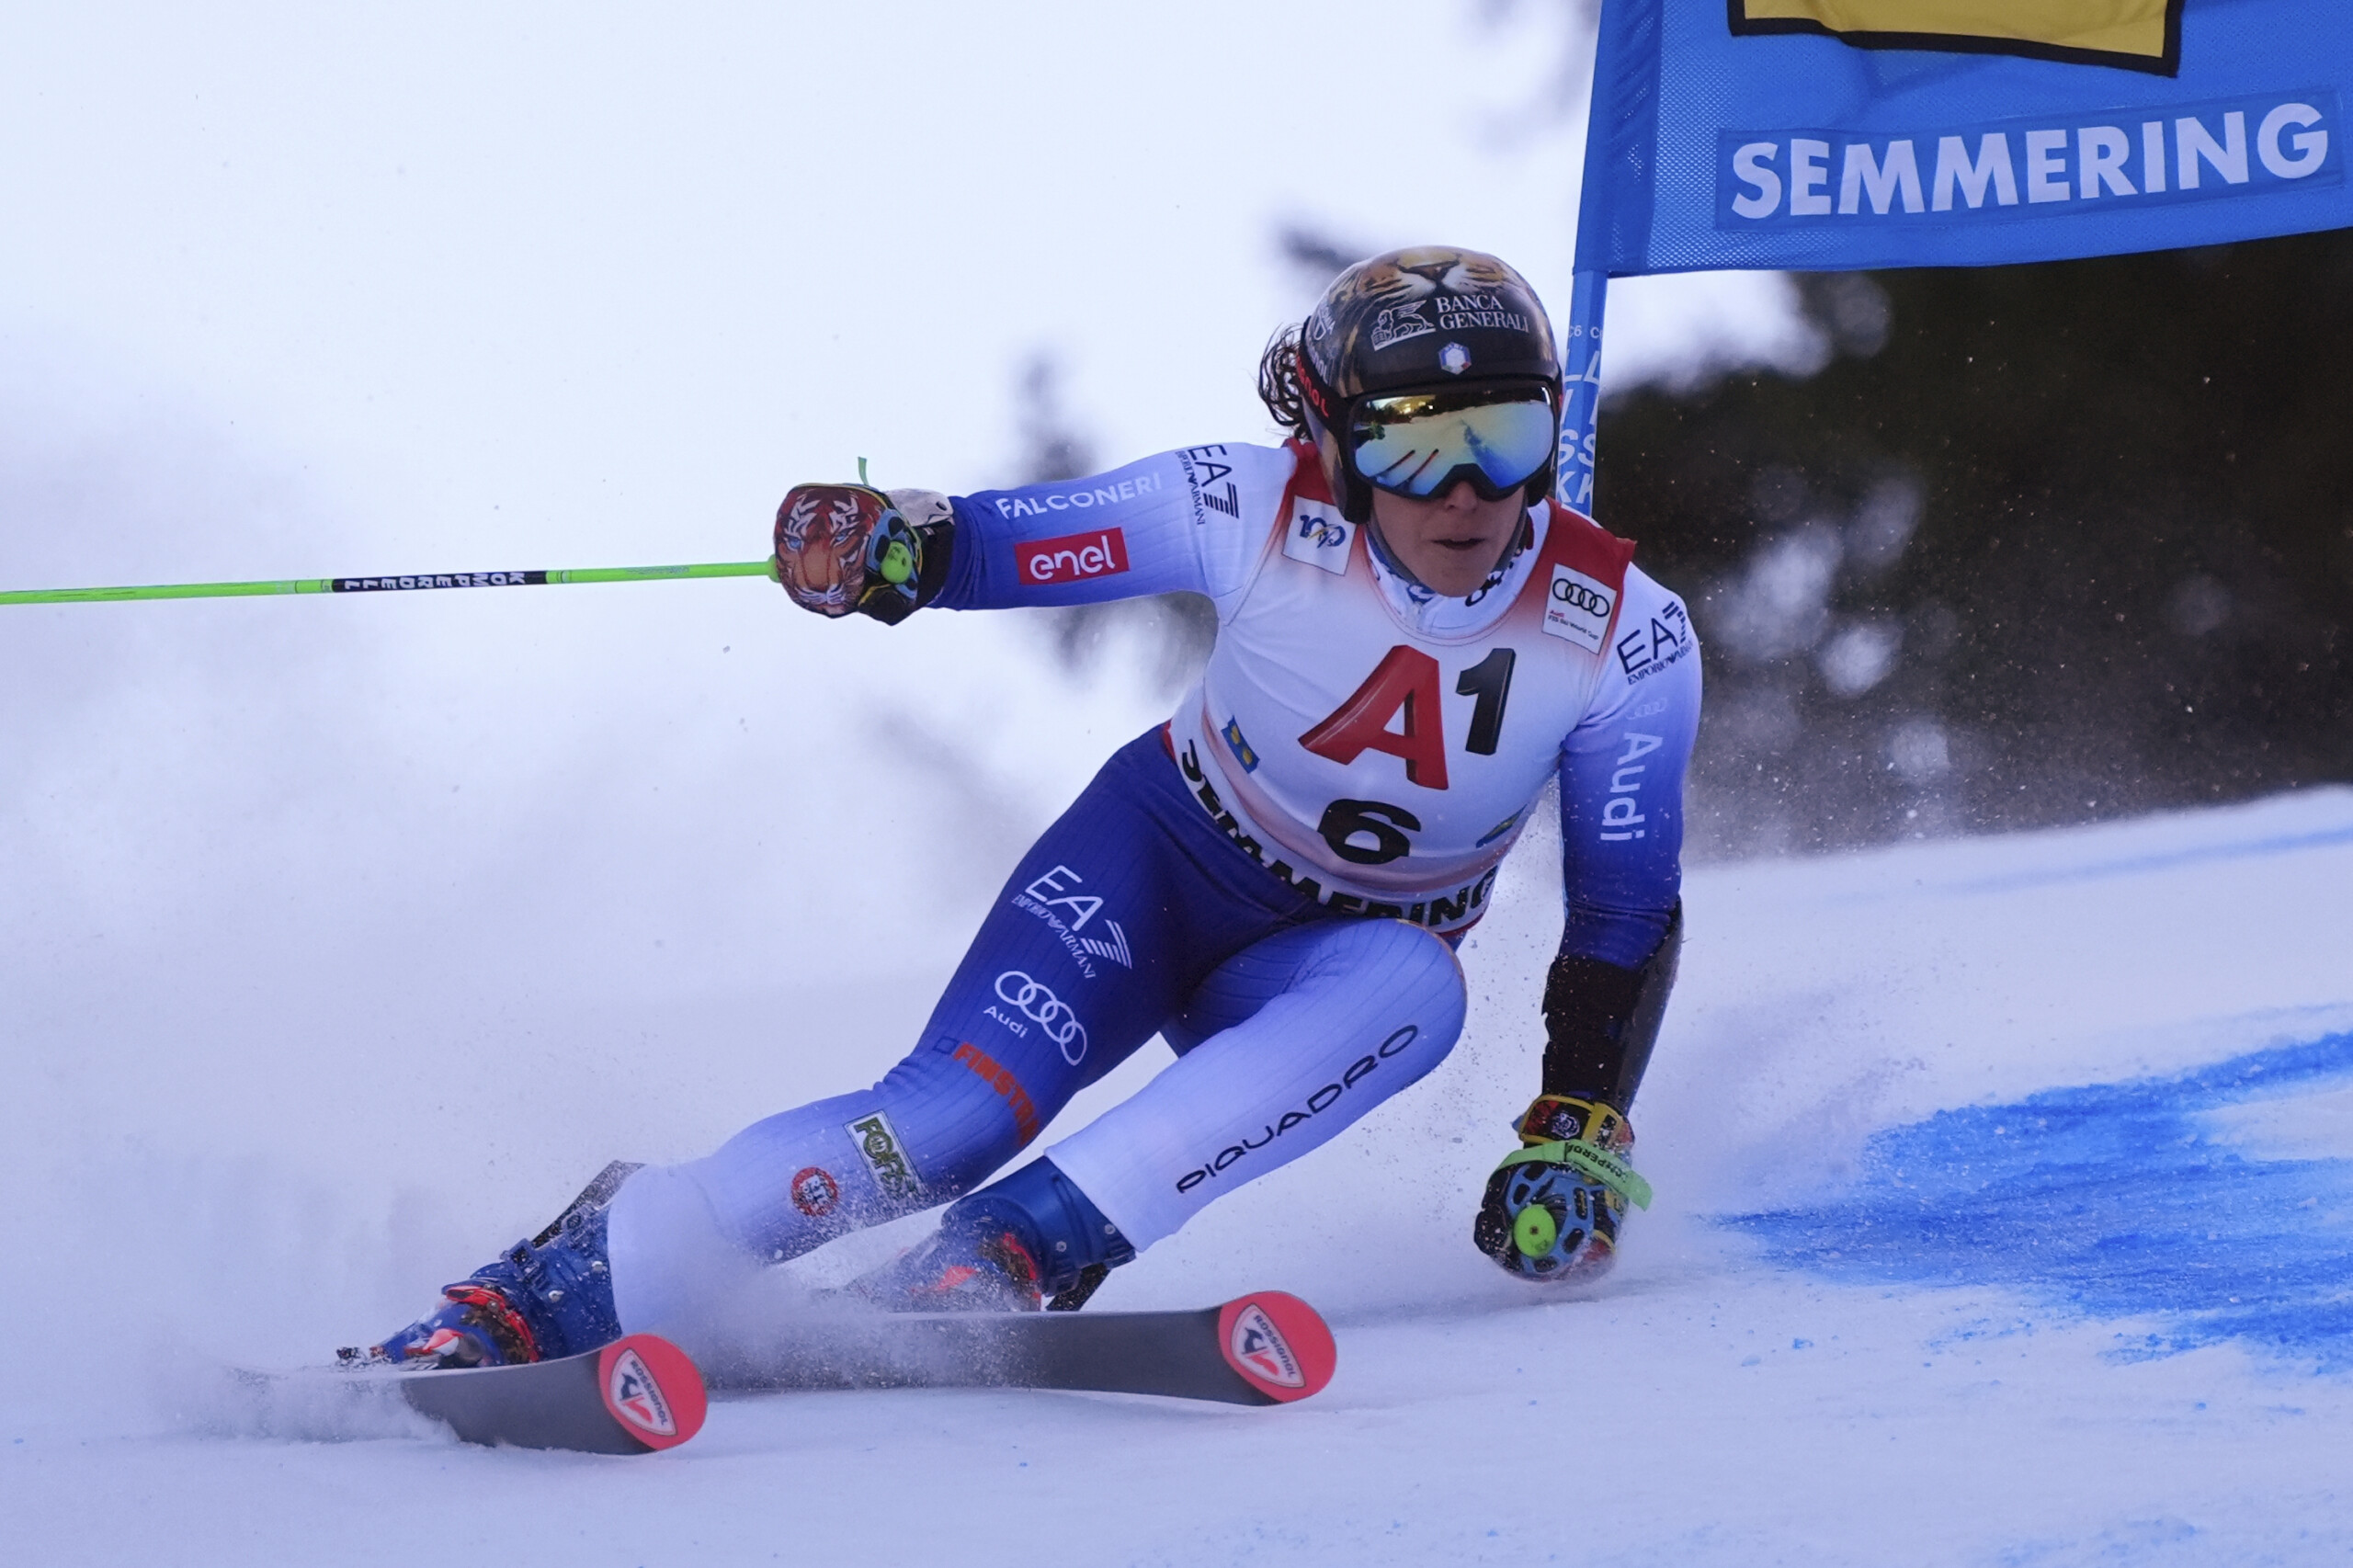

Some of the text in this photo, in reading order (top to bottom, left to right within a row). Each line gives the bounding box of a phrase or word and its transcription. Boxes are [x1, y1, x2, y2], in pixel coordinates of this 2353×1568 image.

[1731, 102, 2329, 220] SEMMERING
[1437, 294, 1504, 313] BANCA
[1439, 310, 1529, 334] GENERALI
[995, 472, 1162, 520] FALCONERI
[1188, 444, 1239, 519] EA7
[345, 571, 526, 590] KOMPERDELL
[1029, 535, 1115, 581] enel
[1617, 601, 1687, 675] EA7
[1298, 644, 1517, 790] A1
[1600, 733, 1663, 841] Audi
[1317, 798, 1421, 865] 6
[1026, 865, 1132, 970] EA7
[1057, 926, 1096, 979] ARMANI
[983, 1006, 1029, 1039] Audi
[1176, 1025, 1418, 1194] PIQUADRO
